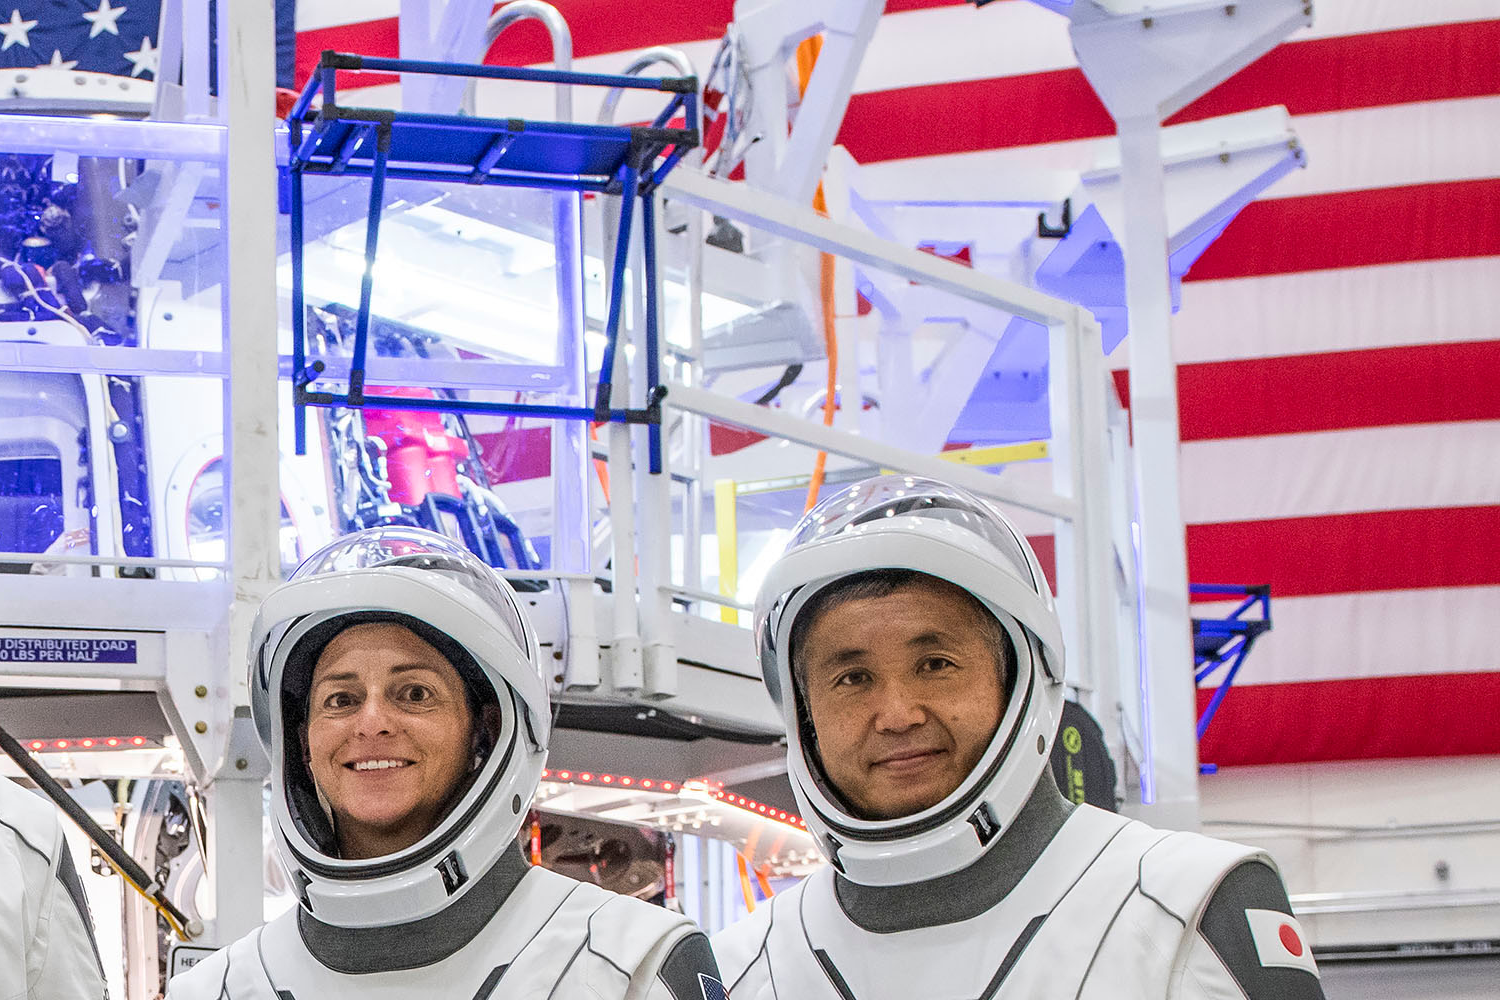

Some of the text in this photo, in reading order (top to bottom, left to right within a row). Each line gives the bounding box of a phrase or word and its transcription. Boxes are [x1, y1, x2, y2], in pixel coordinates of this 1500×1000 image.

[4, 639, 90, 651] DISTRIBUTED
[92, 640, 128, 651] LOAD
[11, 650, 36, 660] LBS
[39, 650, 64, 661] PER
[67, 651, 100, 661] HALF
